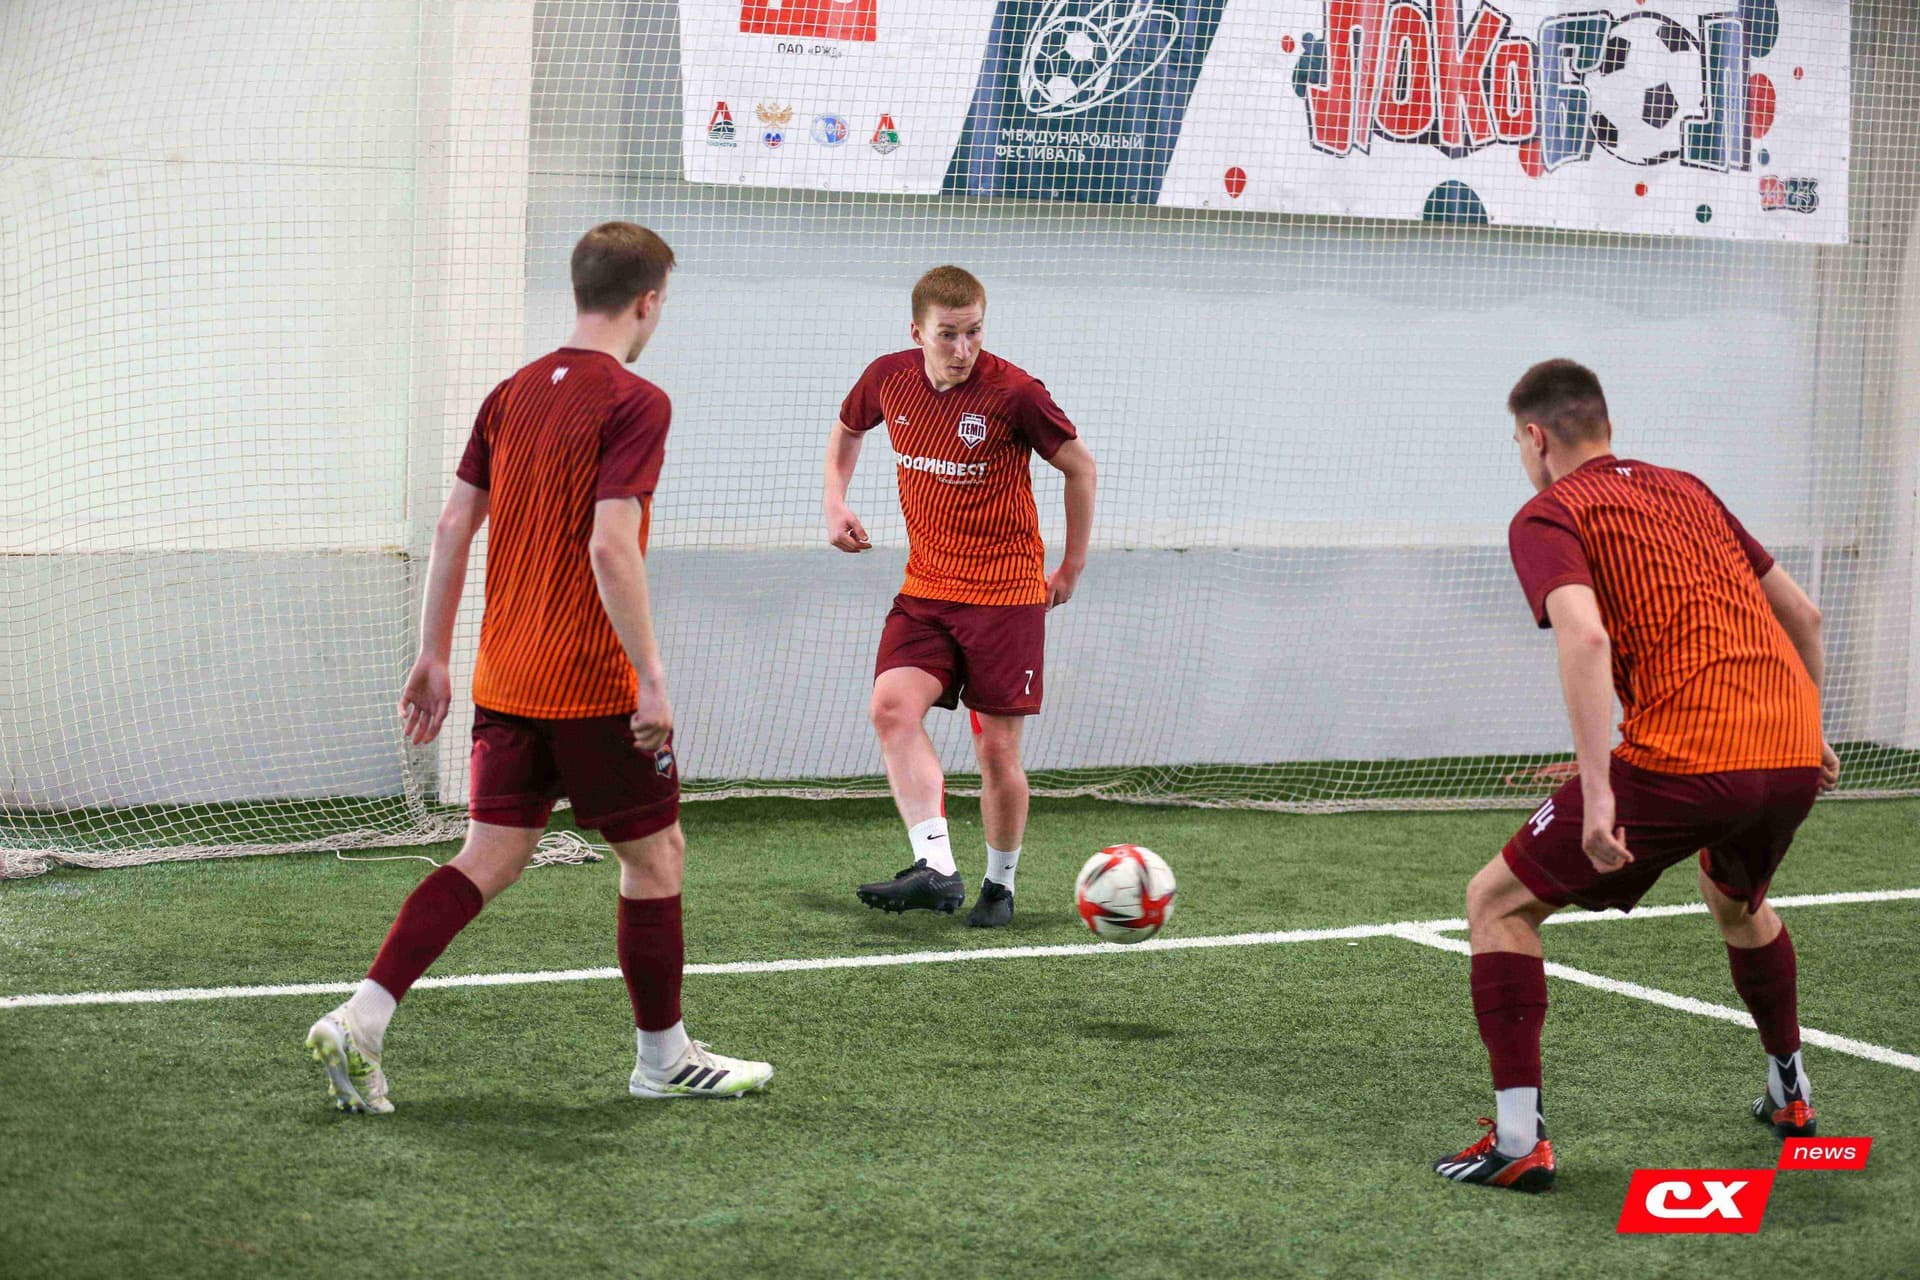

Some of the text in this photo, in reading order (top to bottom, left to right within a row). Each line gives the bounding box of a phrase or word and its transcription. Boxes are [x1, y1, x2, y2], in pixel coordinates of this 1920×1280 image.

[777, 42, 804, 55] ОАО
[1001, 127, 1144, 148] МЕЖДУНАРОДНЫЙ
[994, 146, 1086, 162] ФЕСТИВАЛЬ
[961, 422, 985, 438] ТЕМП
[1024, 670, 1034, 695] 7
[1528, 798, 1555, 837] 14
